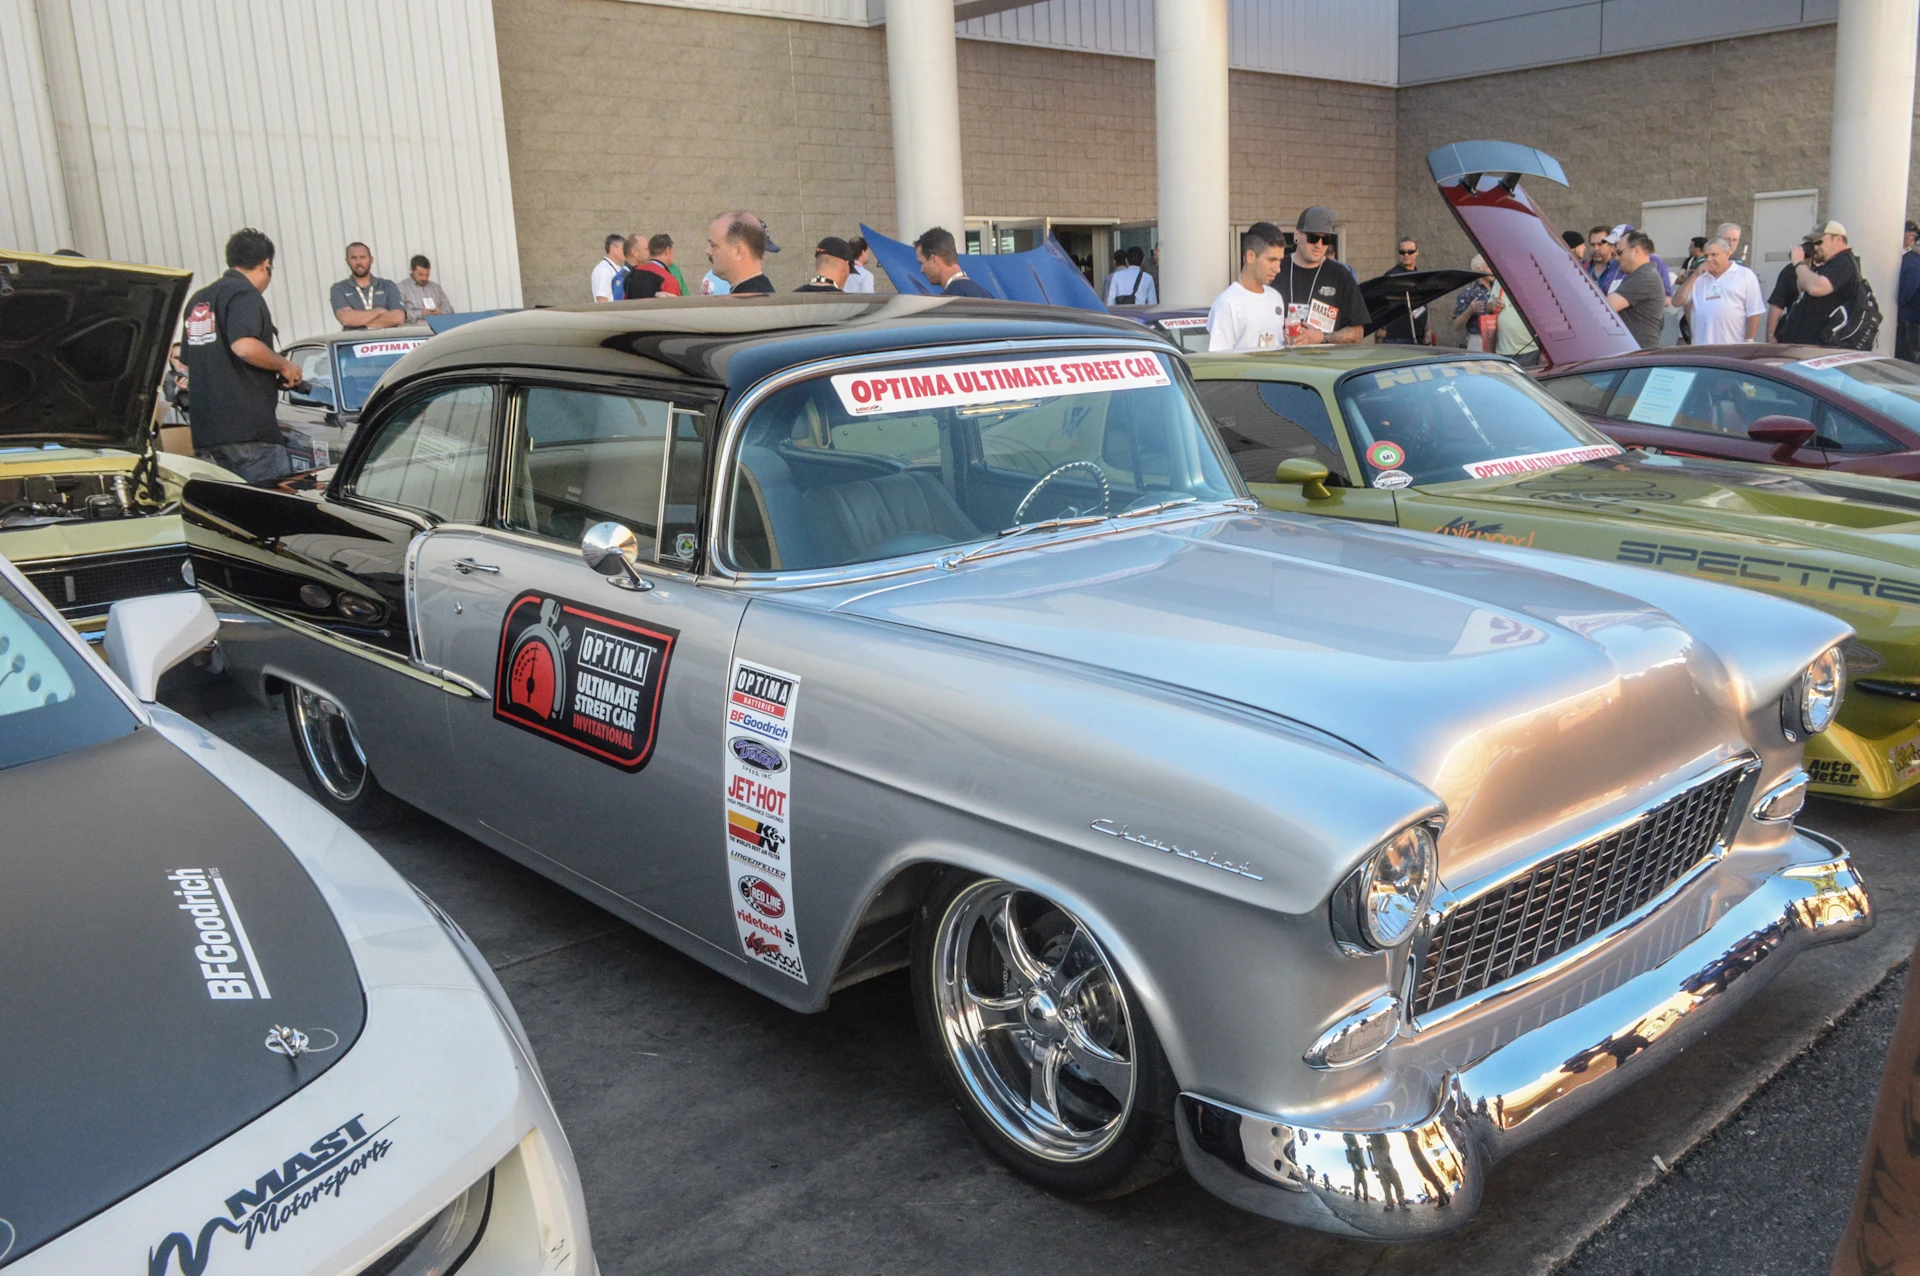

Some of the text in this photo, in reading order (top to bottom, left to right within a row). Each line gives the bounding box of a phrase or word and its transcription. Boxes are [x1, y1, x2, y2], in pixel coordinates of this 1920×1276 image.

[360, 343, 411, 354] OPTIMA
[851, 356, 1161, 403] OPTIMA ULTIMATE STREET CAR
[1382, 453, 1394, 461] MI
[1474, 461, 1527, 479] OPTIMA
[1522, 452, 1577, 471] ULTIMATE
[1571, 448, 1605, 463] STREET
[1616, 539, 1920, 604] SPECTRE
[581, 635, 646, 679] OPTIMA
[576, 670, 640, 713] ULTIMATE
[737, 670, 789, 704] OPTIMA
[573, 692, 637, 732] STREET CAR
[743, 696, 776, 713] BATTERIES
[572, 713, 634, 751] INVITATIONAL
[730, 709, 789, 739] BFGoodrich
[1807, 769, 1860, 783] Meter
[1808, 759, 1852, 772] Auto
[728, 774, 787, 817] JET-HOT
[736, 800, 765, 817] PERFORMANCE
[764, 811, 785, 824] COATINGS
[751, 886, 766, 903] RED
[765, 893, 783, 911] LINE
[168, 868, 254, 1000] BFGoodrich
[737, 908, 783, 940] ridetech
[224, 1112, 368, 1221] MAST
[238, 1138, 394, 1251] Motorsports
